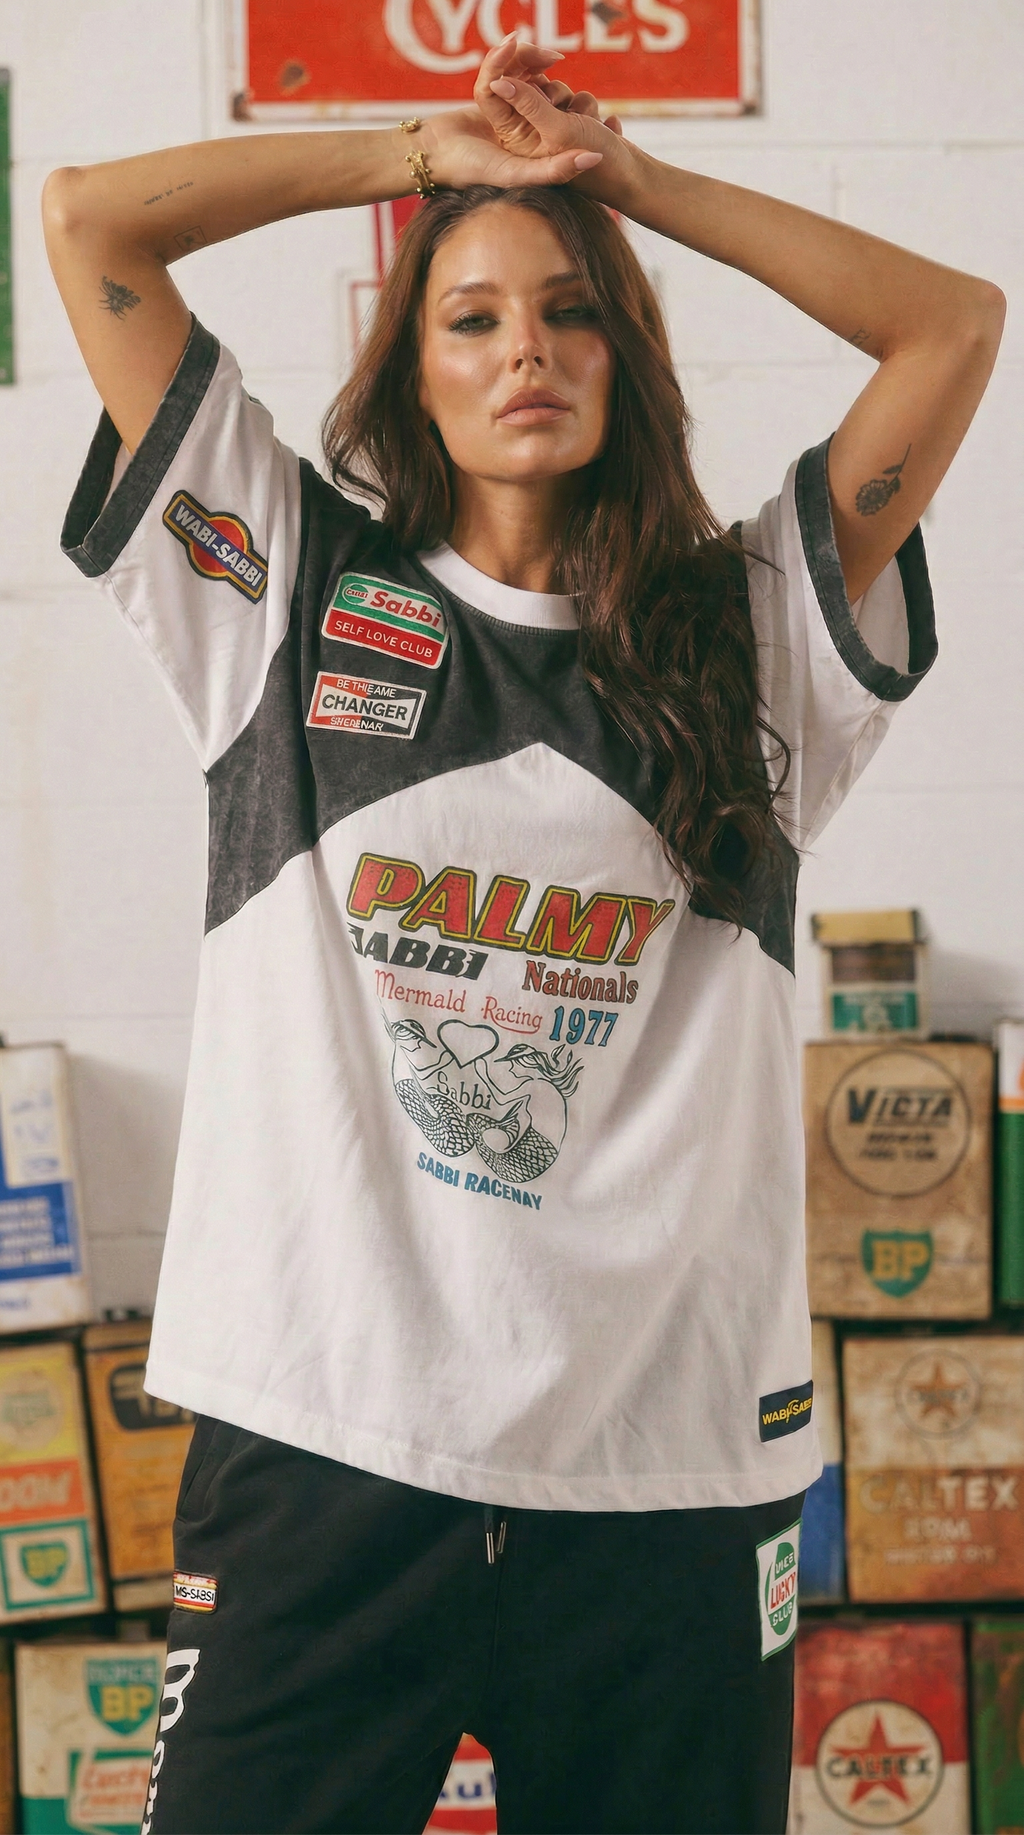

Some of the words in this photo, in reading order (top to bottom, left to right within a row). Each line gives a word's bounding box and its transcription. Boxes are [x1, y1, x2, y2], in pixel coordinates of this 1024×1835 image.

[384, 0, 690, 75] CYCLES
[175, 504, 263, 587] WABI-SABBI
[370, 590, 442, 628] Sabbi
[334, 620, 365, 636] SELF
[366, 629, 398, 647] LOVE
[400, 640, 433, 658] CLUB
[322, 694, 408, 721] CHANGER
[346, 852, 676, 965] PALMY
[522, 960, 639, 1005] Nationals
[481, 996, 543, 1034] Racing
[549, 1005, 619, 1047] 1977
[434, 1071, 491, 1110] Sabbi
[417, 1152, 460, 1187] SABBI
[871, 1238, 930, 1282] BP
[859, 1475, 1019, 1514] CALTEX
[102, 1684, 154, 1722] BP
